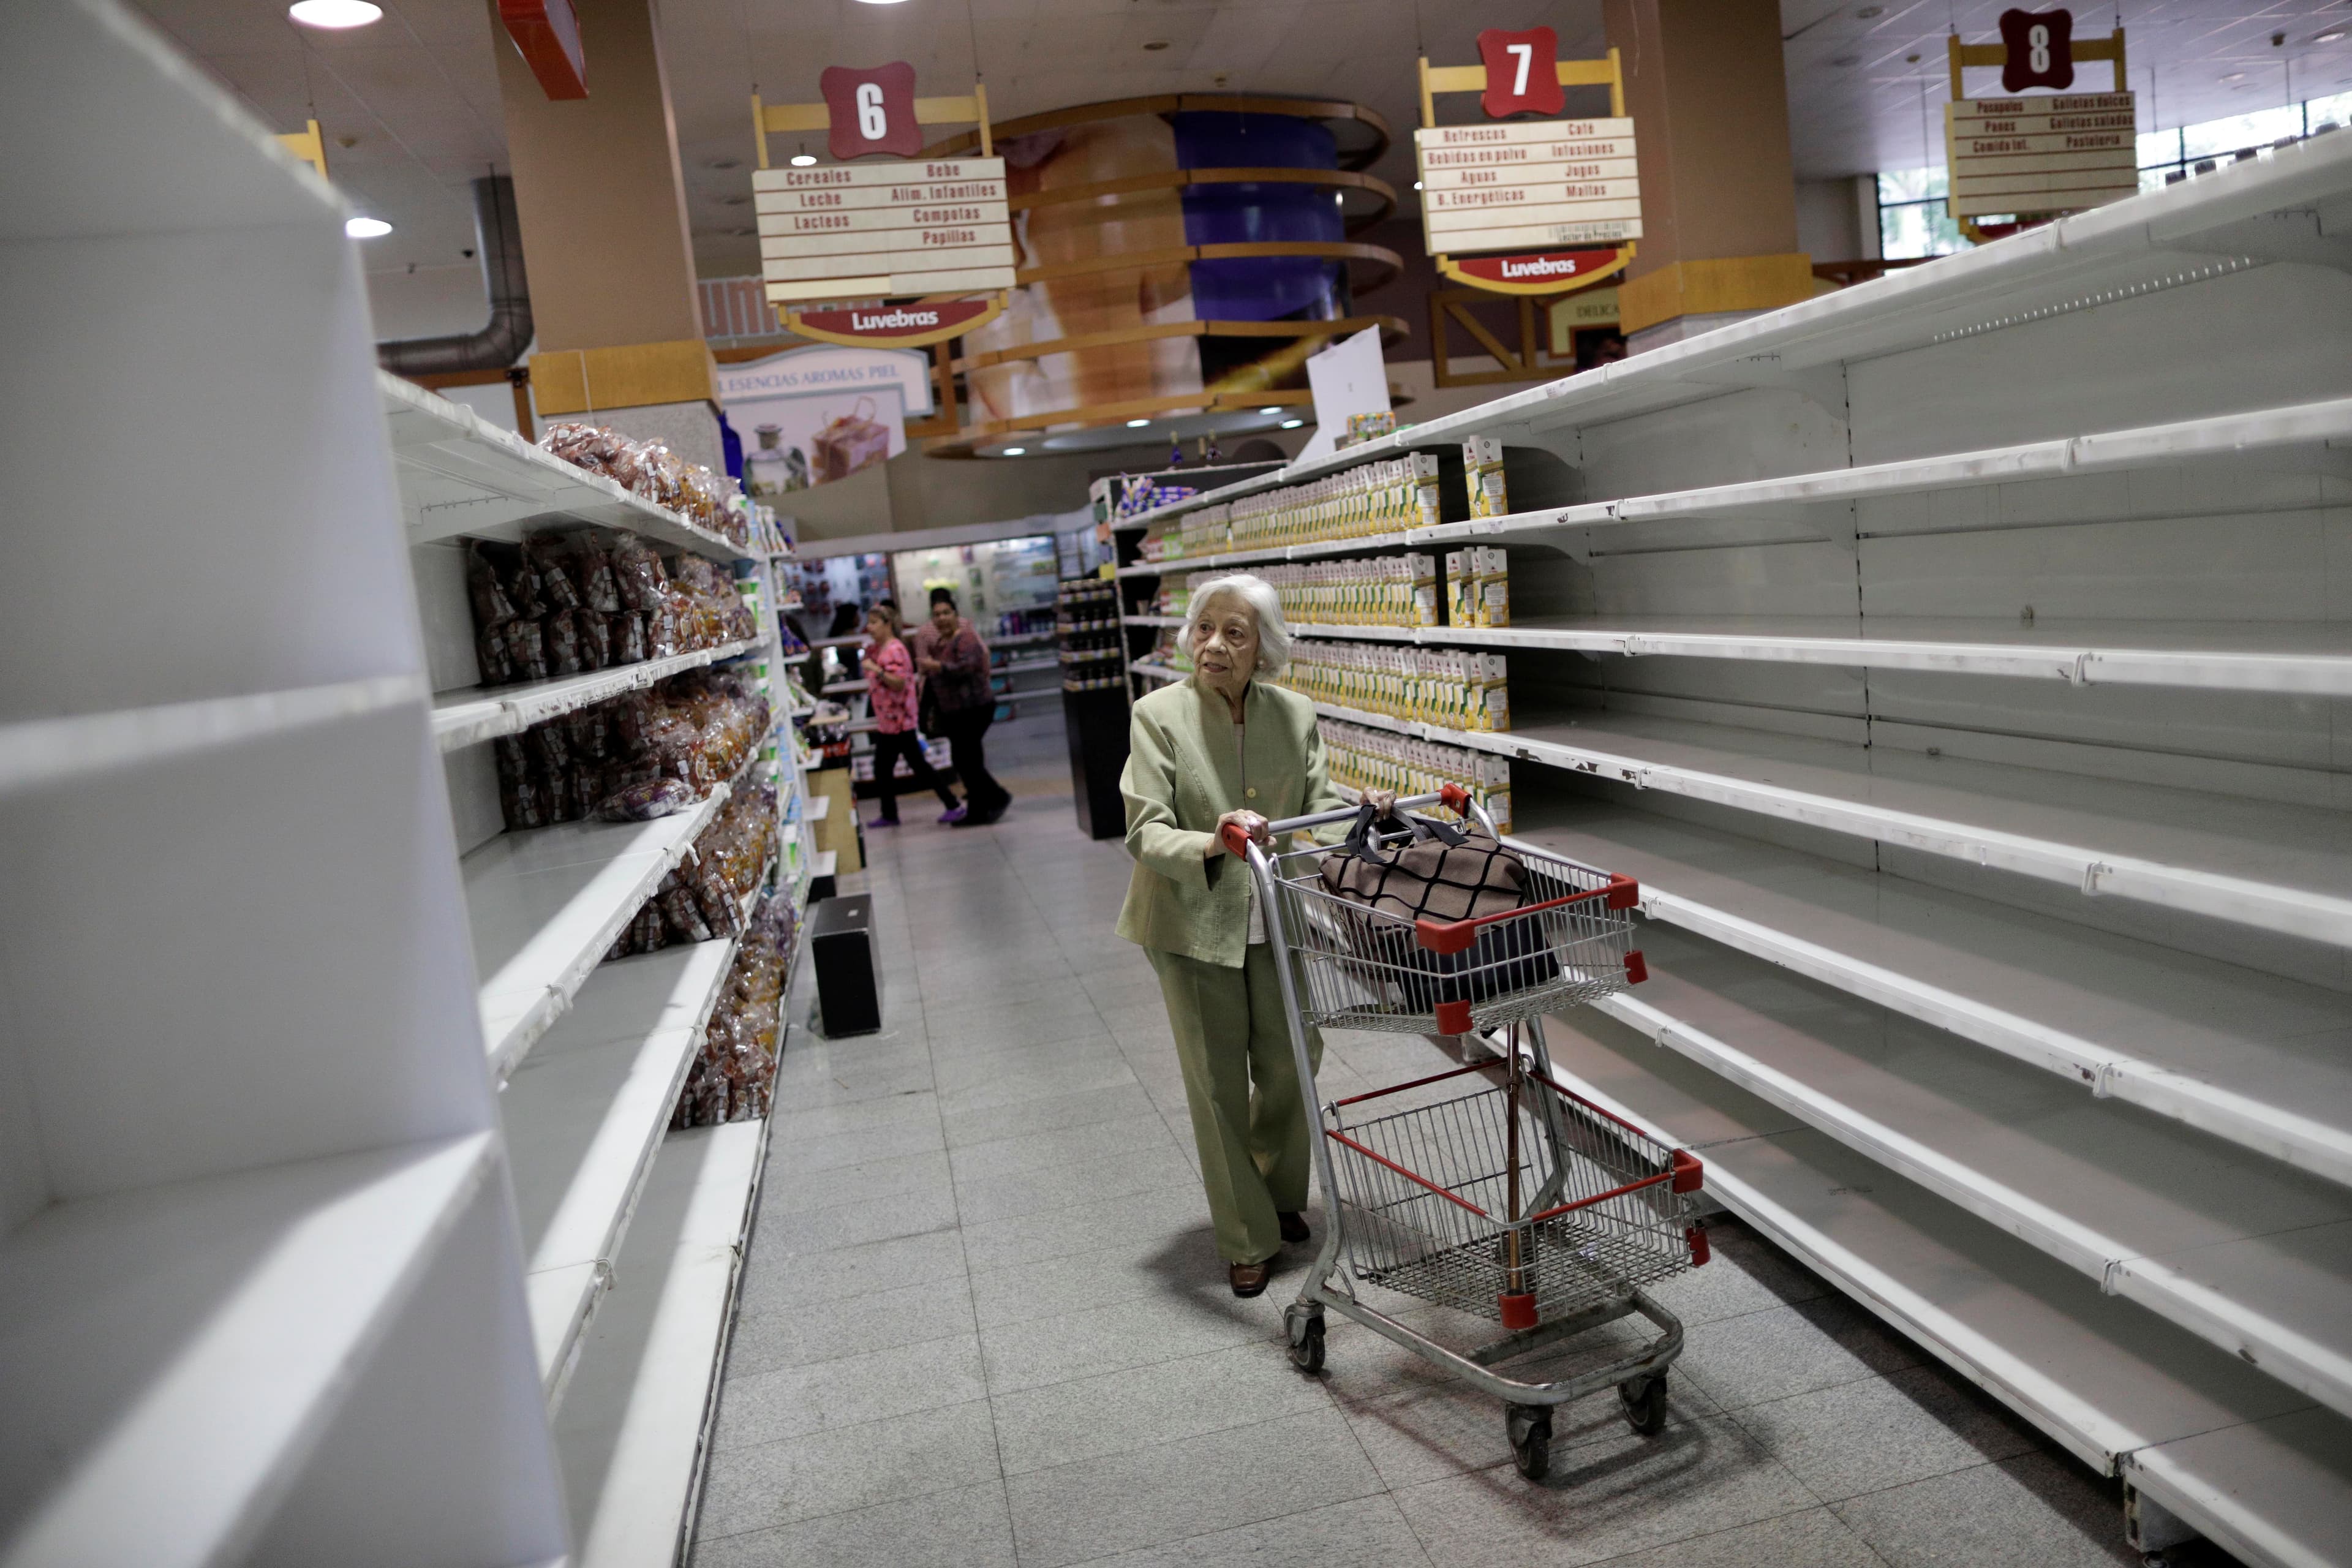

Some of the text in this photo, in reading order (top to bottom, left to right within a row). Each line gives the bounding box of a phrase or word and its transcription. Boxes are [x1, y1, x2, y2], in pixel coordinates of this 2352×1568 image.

[2029, 24, 2050, 74] 8
[1507, 43, 1532, 96] 7
[856, 83, 887, 140] 6
[1985, 121, 2016, 132] Panes
[1444, 129, 1506, 142] Refrescos
[1428, 148, 1526, 164] Bebidas en polvo
[1551, 143, 1614, 157] Infusiones
[786, 170, 851, 185] Cereales
[1461, 171, 1496, 185] Aguas
[1565, 164, 1600, 177] Jugos
[892, 184, 997, 202] Alim. Infantiles
[1566, 185, 1606, 197] Maltas
[801, 192, 841, 207] Leche
[913, 208, 980, 223] Compotas
[922, 230, 976, 245] Papillas
[1501, 257, 1575, 277] Luvebras
[852, 310, 938, 331] Luvebras
[728, 371, 799, 392] ESENCIAS
[802, 366, 864, 385] AROMAS
[869, 364, 900, 377] PIEL
